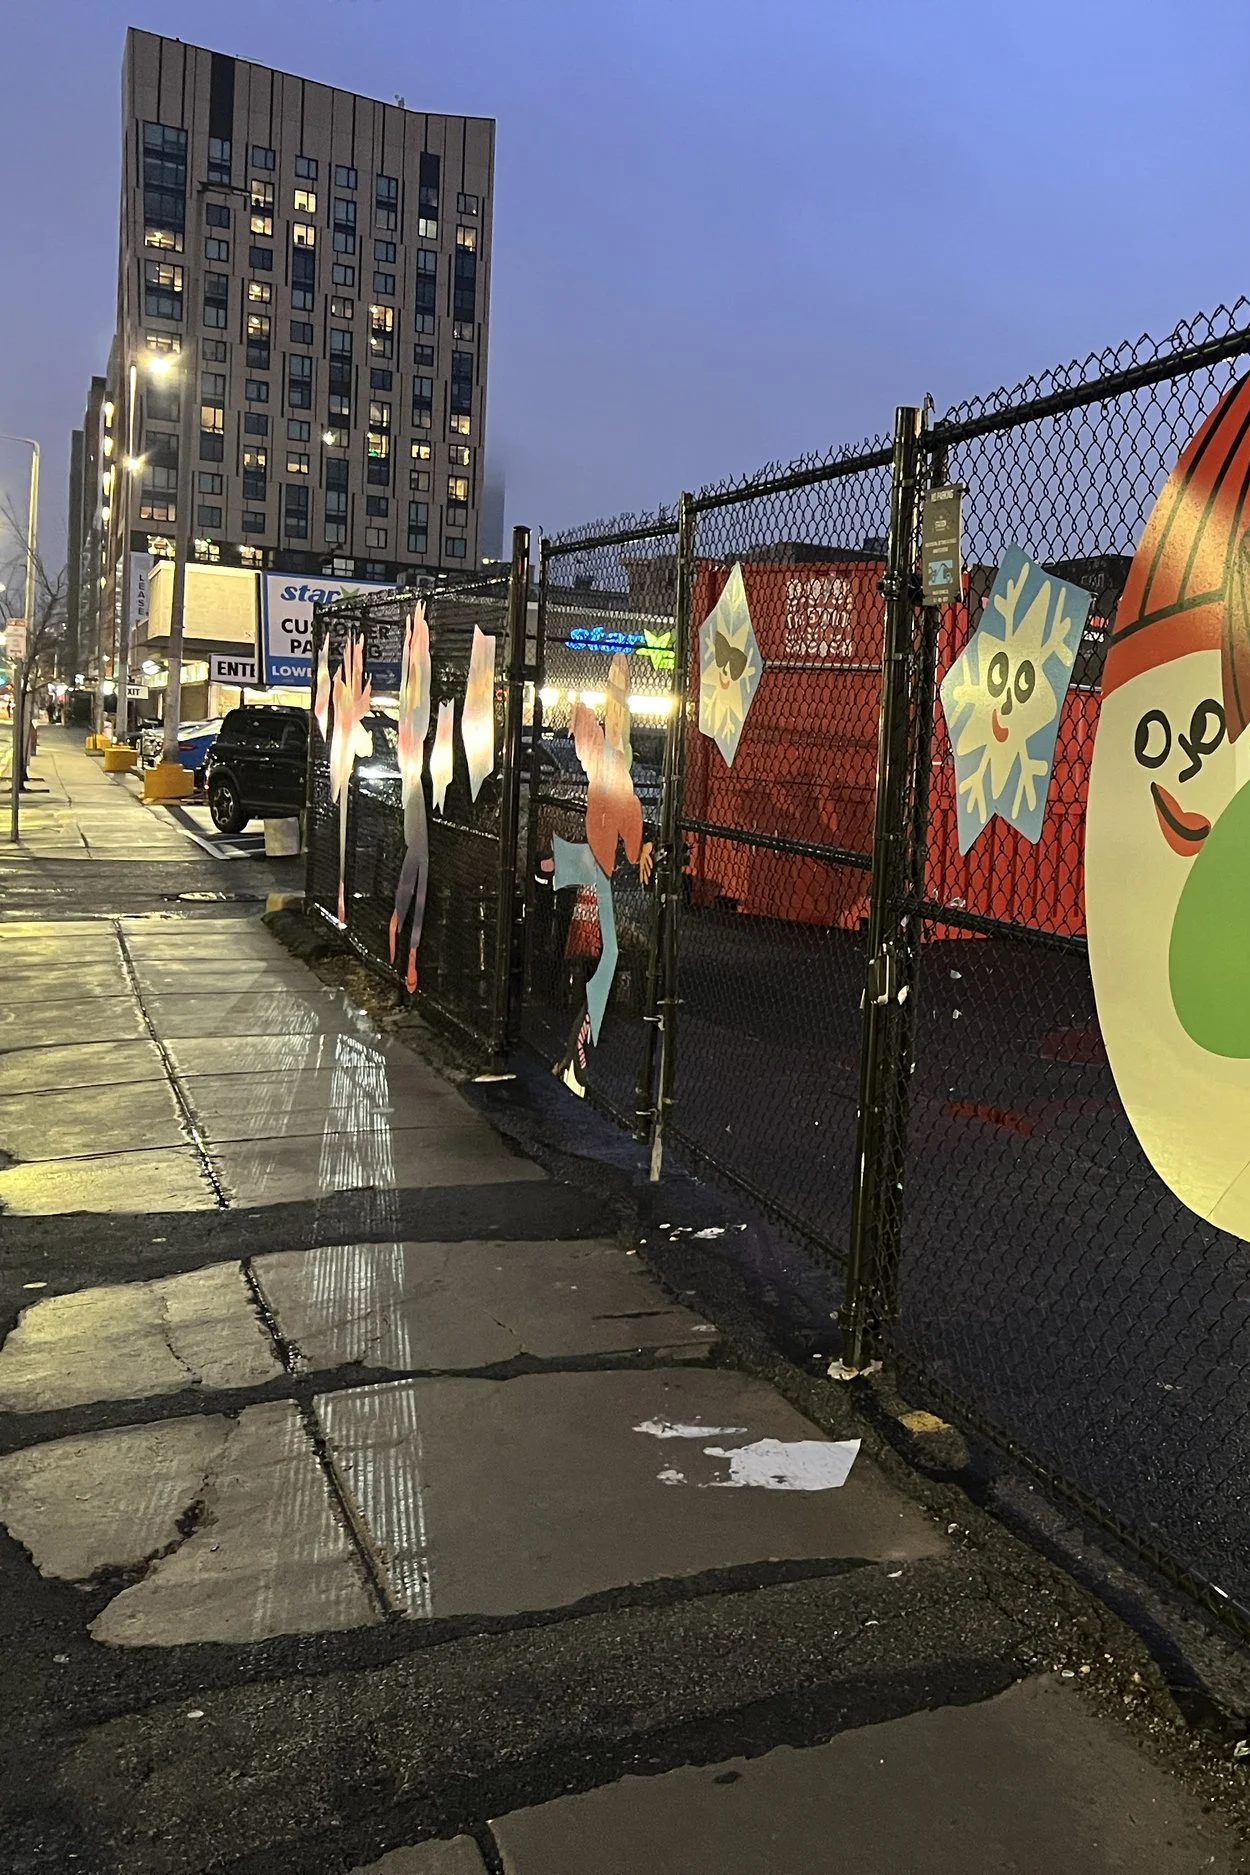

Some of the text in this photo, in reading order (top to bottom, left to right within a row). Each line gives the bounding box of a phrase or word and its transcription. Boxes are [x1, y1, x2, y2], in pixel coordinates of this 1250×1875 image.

[138, 574, 146, 616] LEASE
[280, 584, 341, 605] star
[281, 618, 390, 640] CUTOER
[127, 688, 140, 696] XIT
